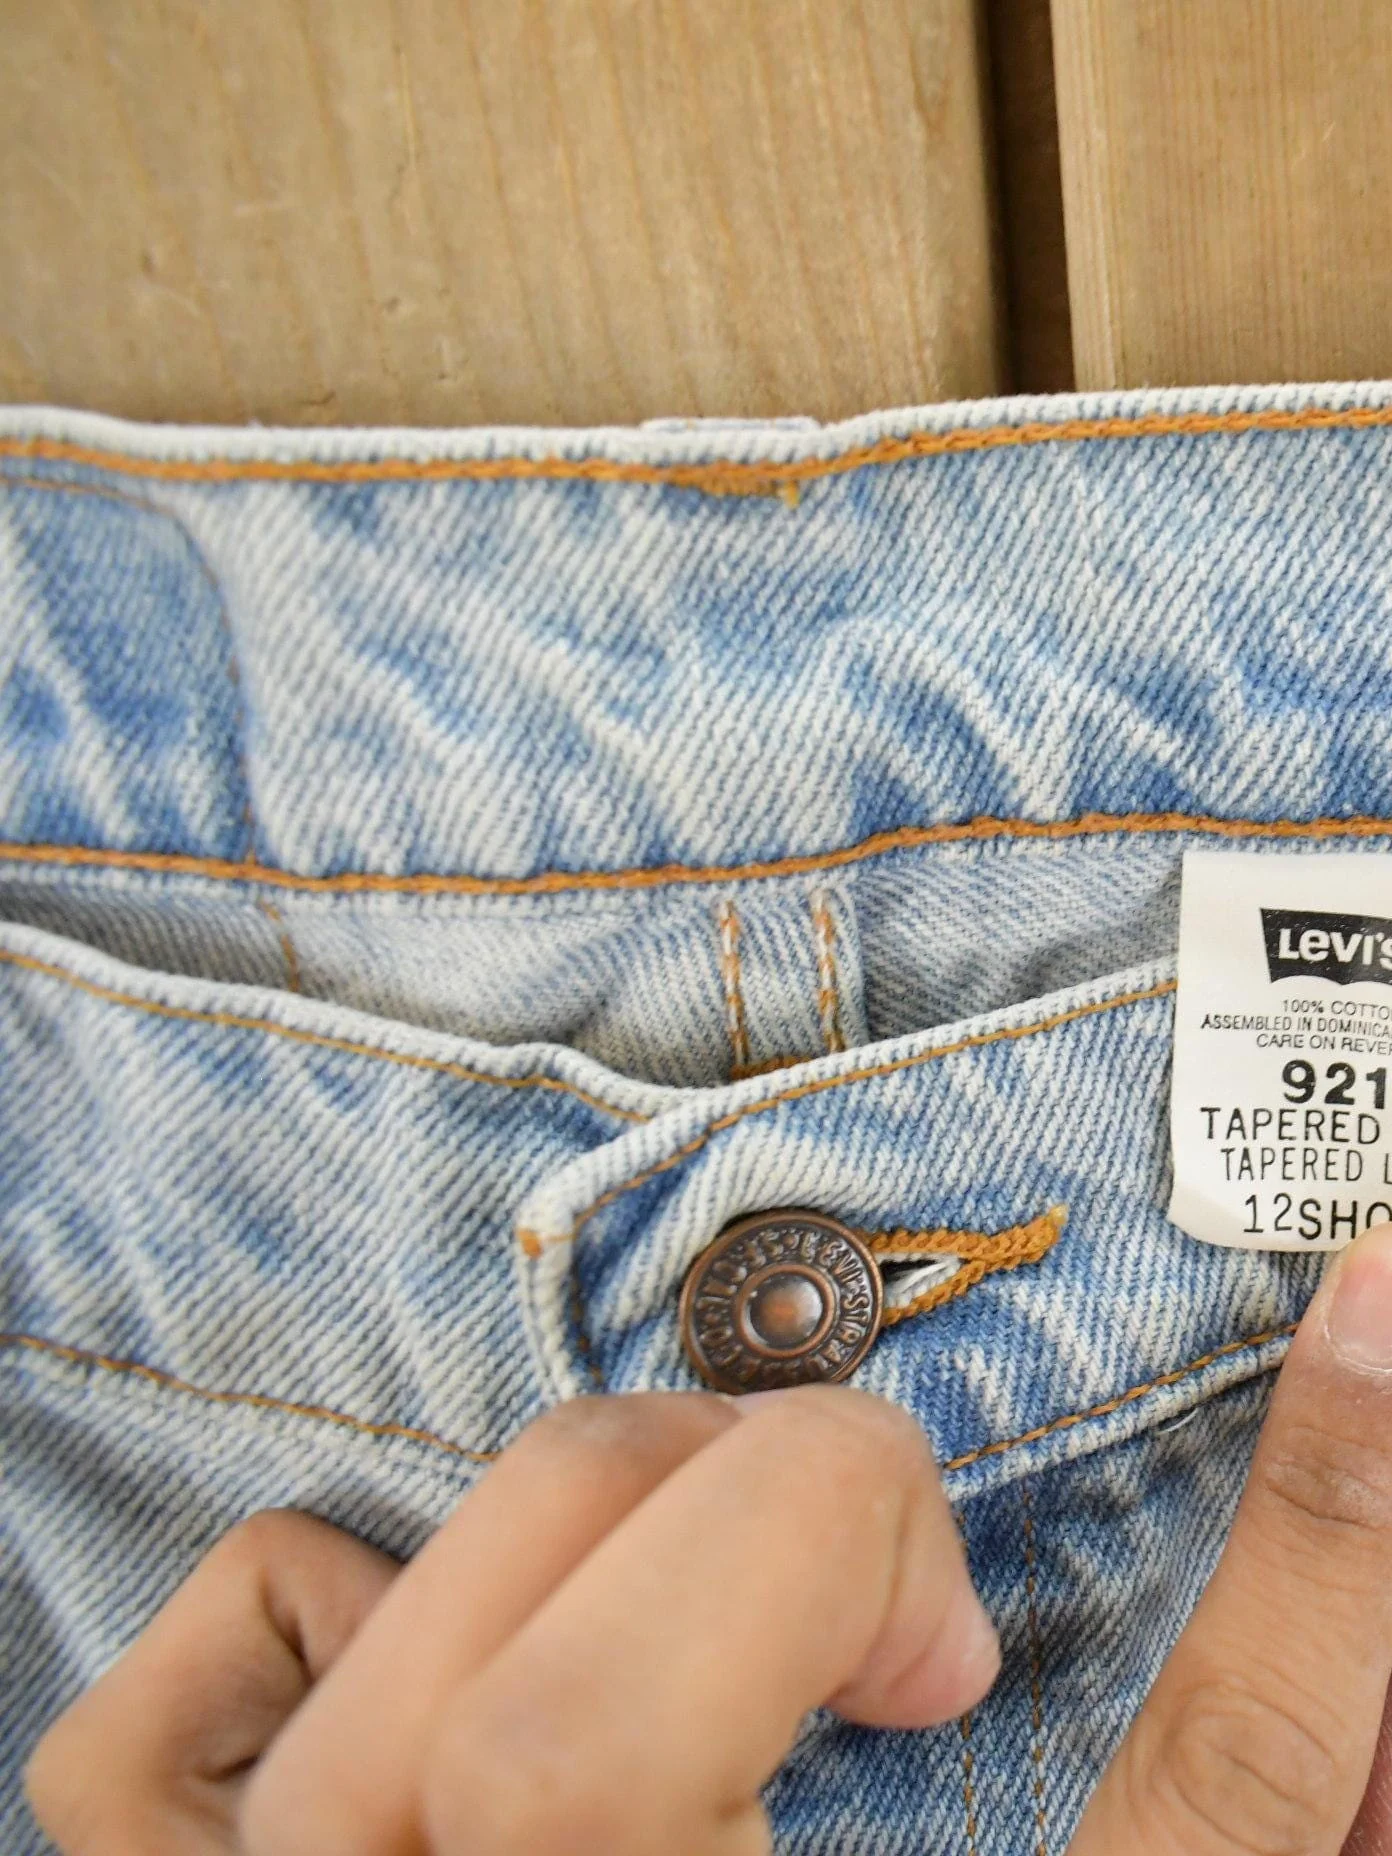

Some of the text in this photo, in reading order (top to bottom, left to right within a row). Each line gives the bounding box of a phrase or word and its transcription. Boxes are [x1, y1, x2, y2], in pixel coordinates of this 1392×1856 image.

[1282, 999, 1325, 1014] 100%
[1200, 1014, 1292, 1031] ASSEMBLED
[1295, 1016, 1312, 1032] IN
[1256, 1033, 1304, 1049] CARE
[1309, 1035, 1336, 1050] ON
[1281, 1059, 1388, 1110] 921
[1200, 1106, 1380, 1145] TAPERED
[1220, 1147, 1363, 1182] TAPERED
